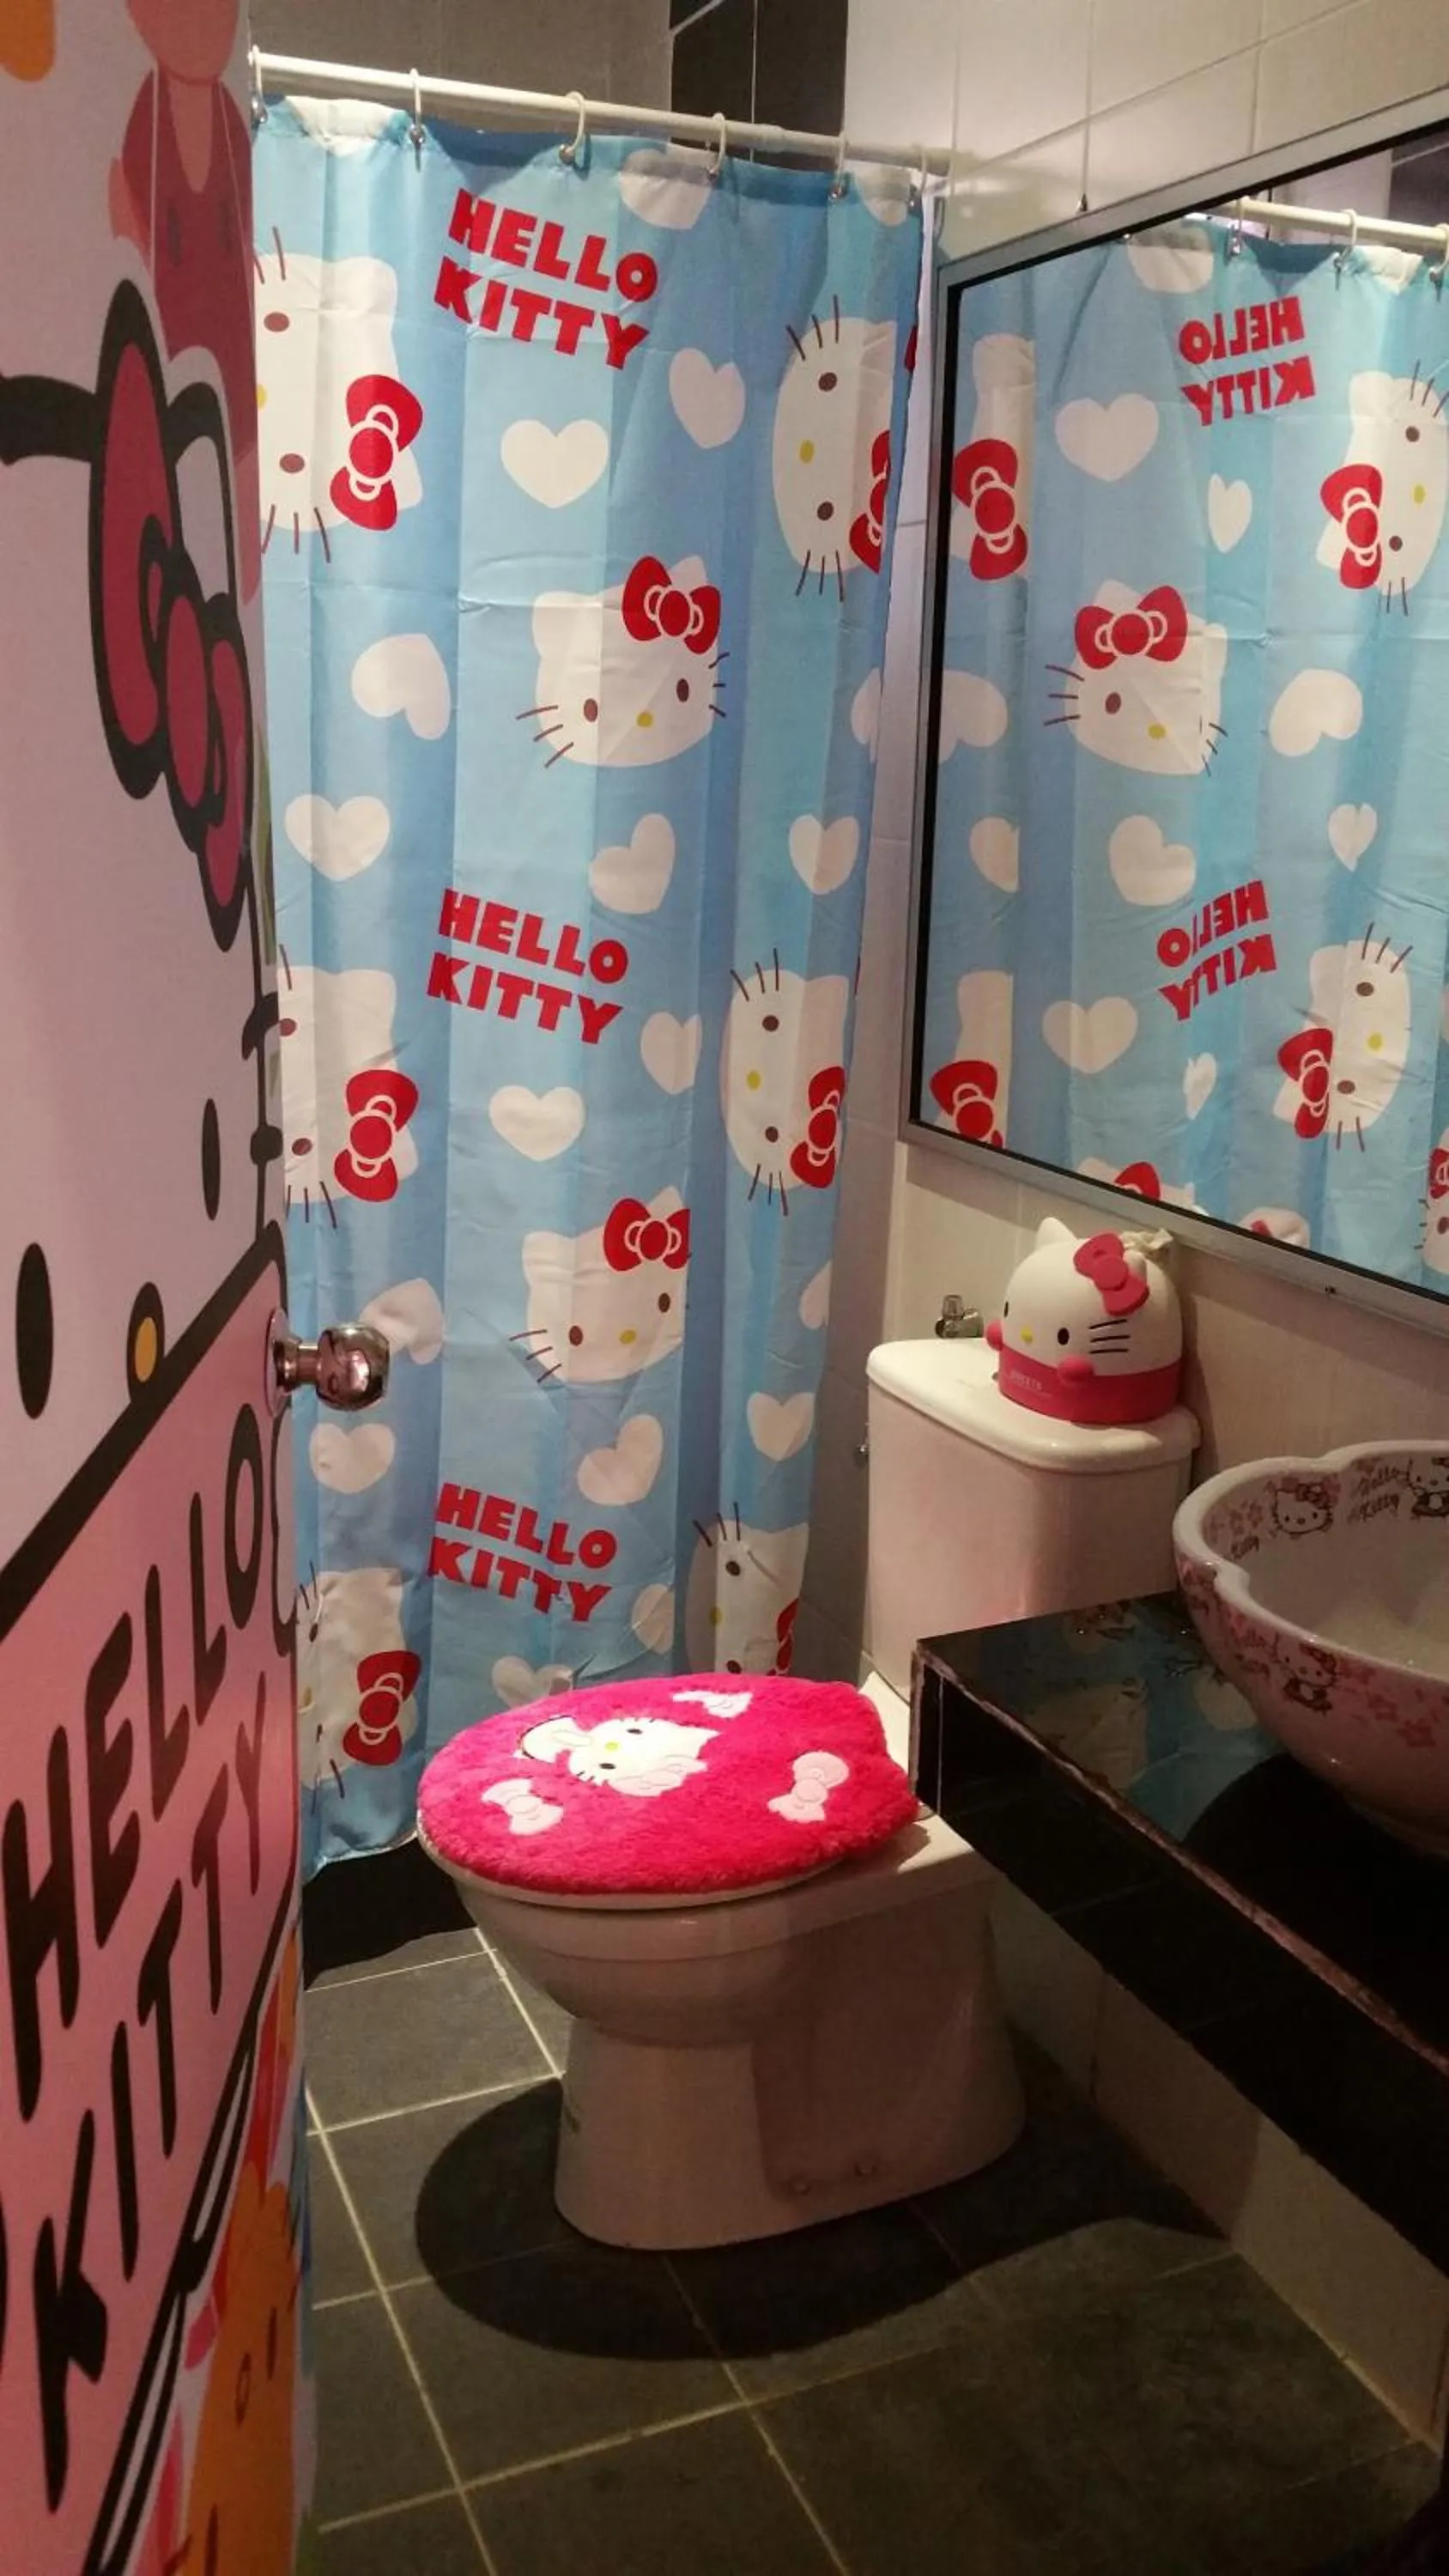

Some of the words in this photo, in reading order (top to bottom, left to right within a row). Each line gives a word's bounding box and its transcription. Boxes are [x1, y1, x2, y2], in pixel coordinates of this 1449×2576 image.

[448, 188, 658, 304] HELLO
[433, 256, 650, 370] KITTY
[438, 888, 629, 984] HELLO
[426, 951, 625, 1045] KITTY
[433, 1482, 617, 1570] HELLO
[426, 1535, 613, 1623] KITTY
[2, 1402, 264, 2123] HELLO
[33, 1670, 267, 2514] KITTY
